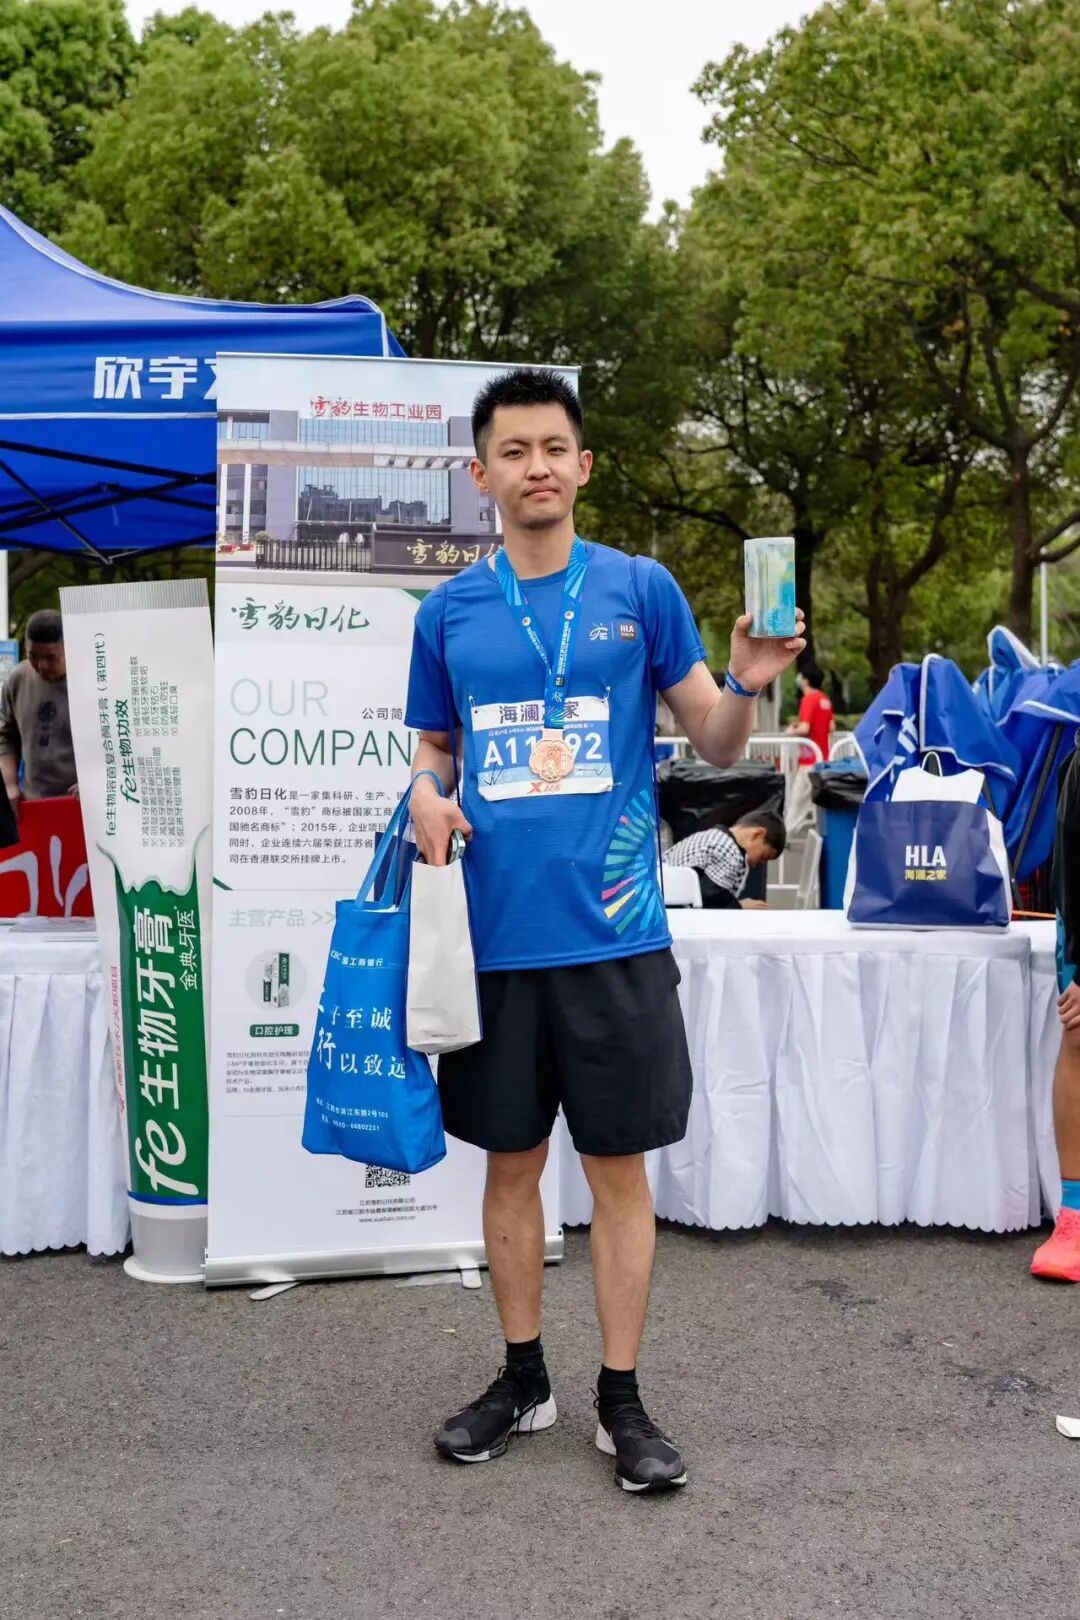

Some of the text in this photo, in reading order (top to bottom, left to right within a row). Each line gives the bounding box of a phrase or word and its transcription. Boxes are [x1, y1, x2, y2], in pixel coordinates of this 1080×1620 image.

[310, 396, 443, 419] 雪豹生物工业园
[231, 597, 370, 632] 雪豹日化
[230, 678, 328, 717] OUR
[499, 701, 580, 724] 海澜家
[115, 699, 141, 804] fe生物功效
[230, 727, 420, 766] COMPAN
[905, 845, 947, 867] HLA
[254, 1025, 294, 1036] 口腔护理
[317, 1027, 406, 1079] 行以致远
